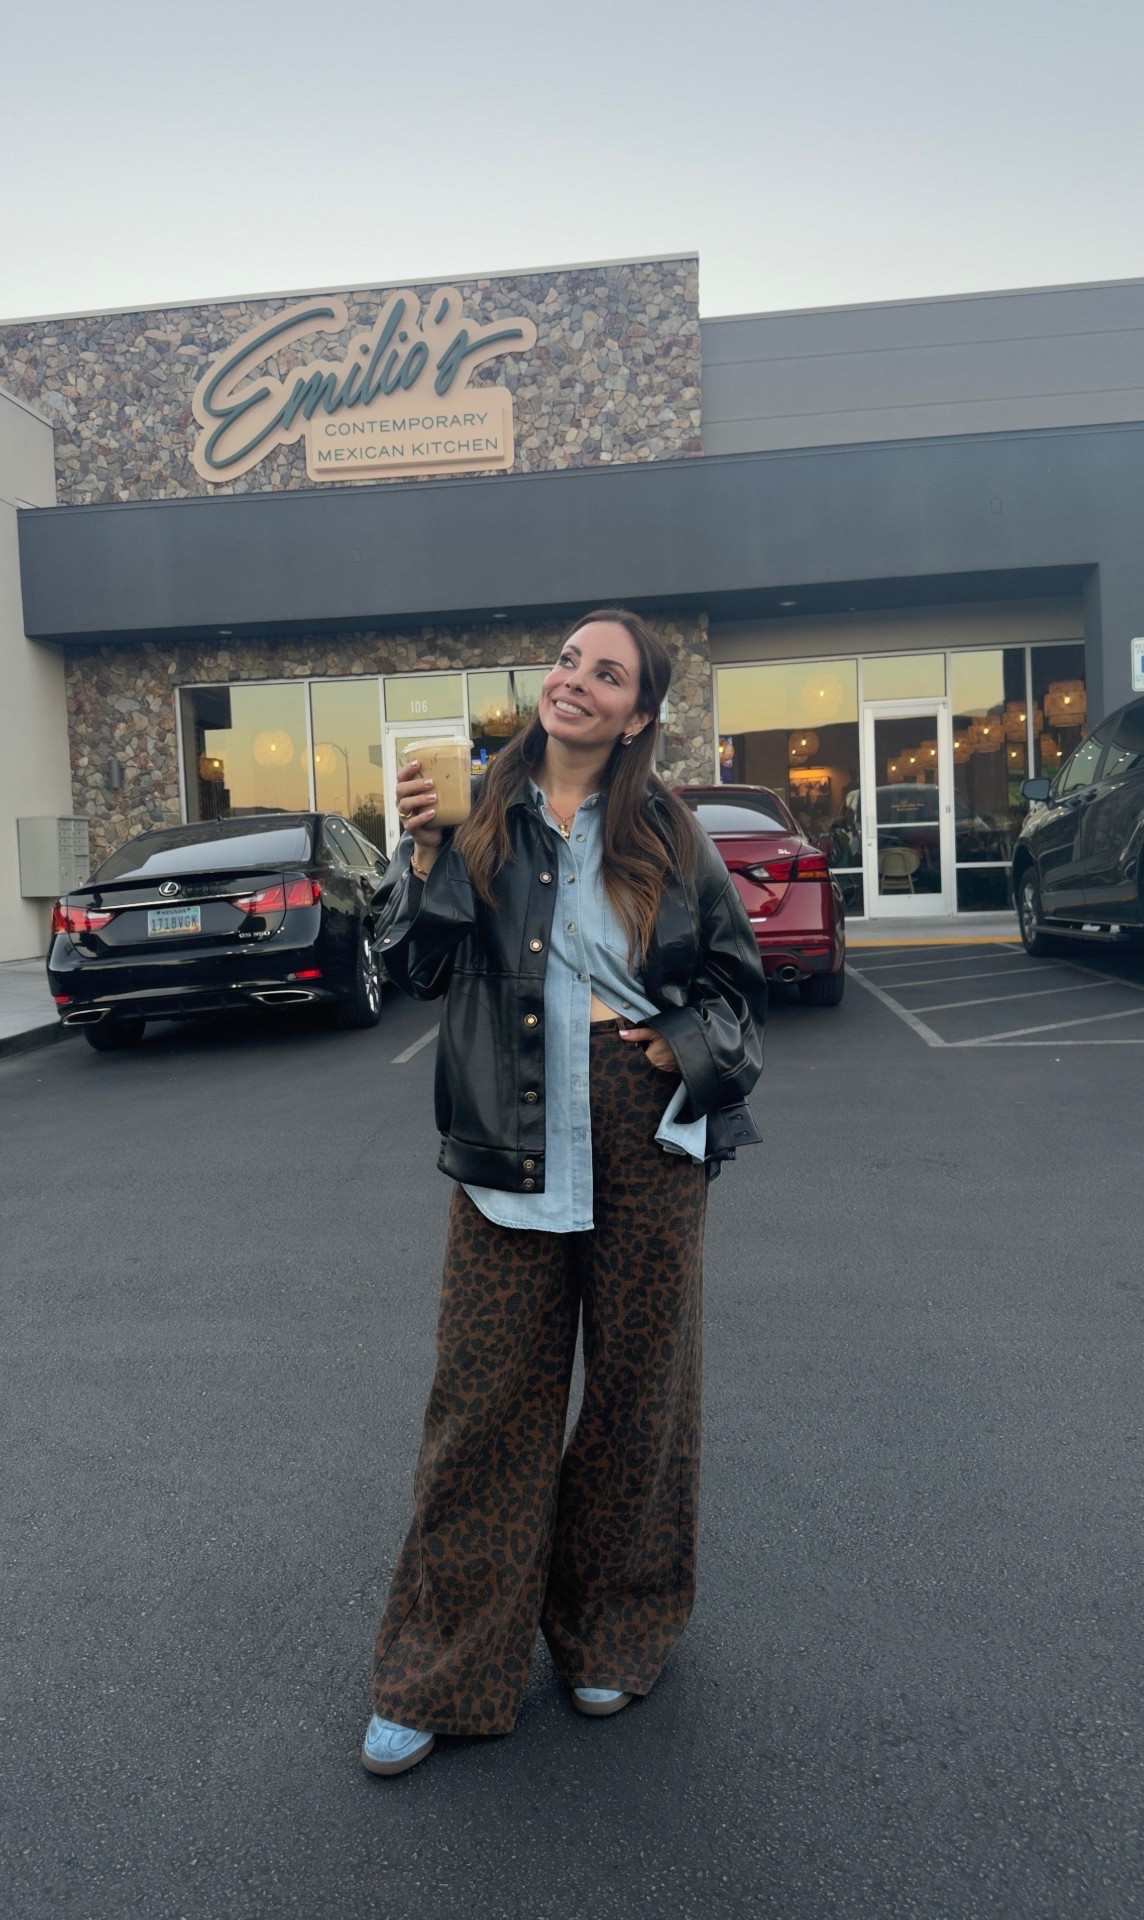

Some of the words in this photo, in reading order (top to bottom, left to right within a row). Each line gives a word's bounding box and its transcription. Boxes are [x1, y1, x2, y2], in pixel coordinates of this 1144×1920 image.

[202, 297, 523, 469] Emilio's
[324, 412, 488, 437] CONTEMPORARY
[318, 444, 404, 462] MEXICAN
[412, 437, 498, 456] KITCHEN
[410, 700, 428, 714] 106
